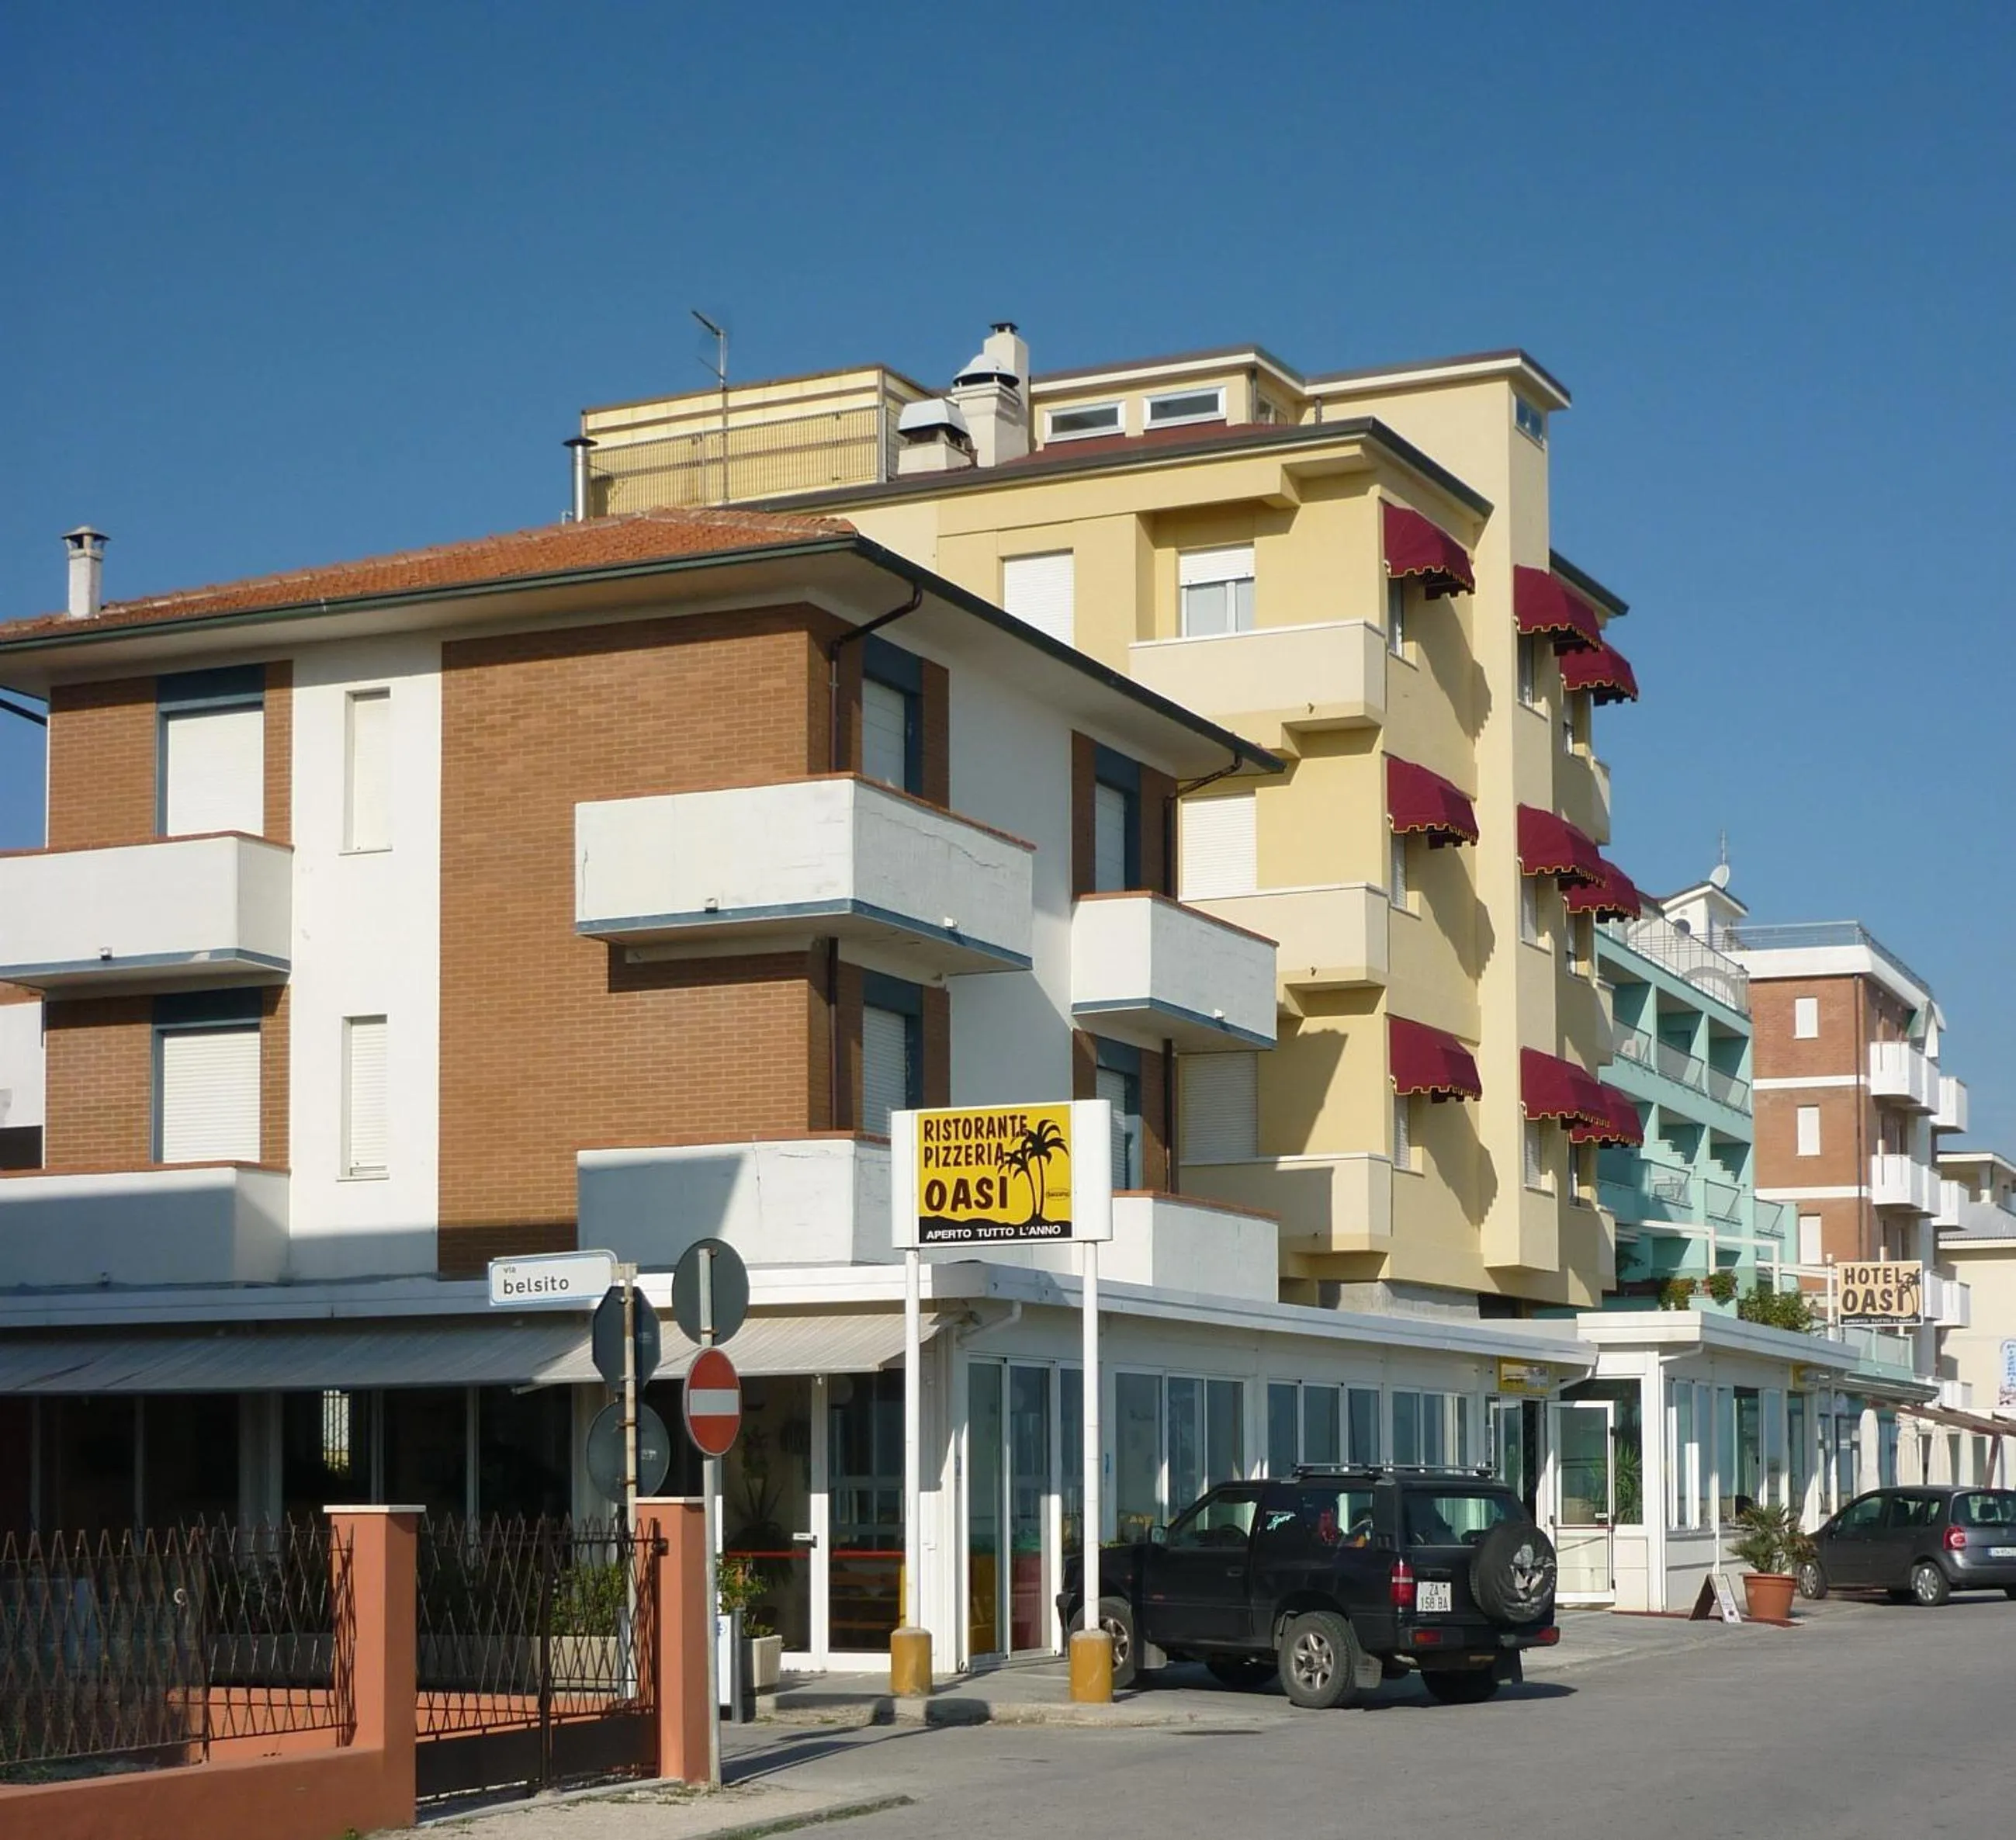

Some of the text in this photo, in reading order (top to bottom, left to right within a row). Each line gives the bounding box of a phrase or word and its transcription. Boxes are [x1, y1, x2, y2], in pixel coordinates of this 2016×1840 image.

[923, 1115, 1027, 1142] RISTORANTE
[923, 1142, 1005, 1168] PIZZERIA
[925, 1176, 1007, 1212] OASI
[927, 1225, 1061, 1239] APERTO TUTTO L'ANNO
[503, 1276, 570, 1295] belsito
[1844, 1267, 1903, 1284] HOTEL
[1842, 1288, 1903, 1312] OASI
